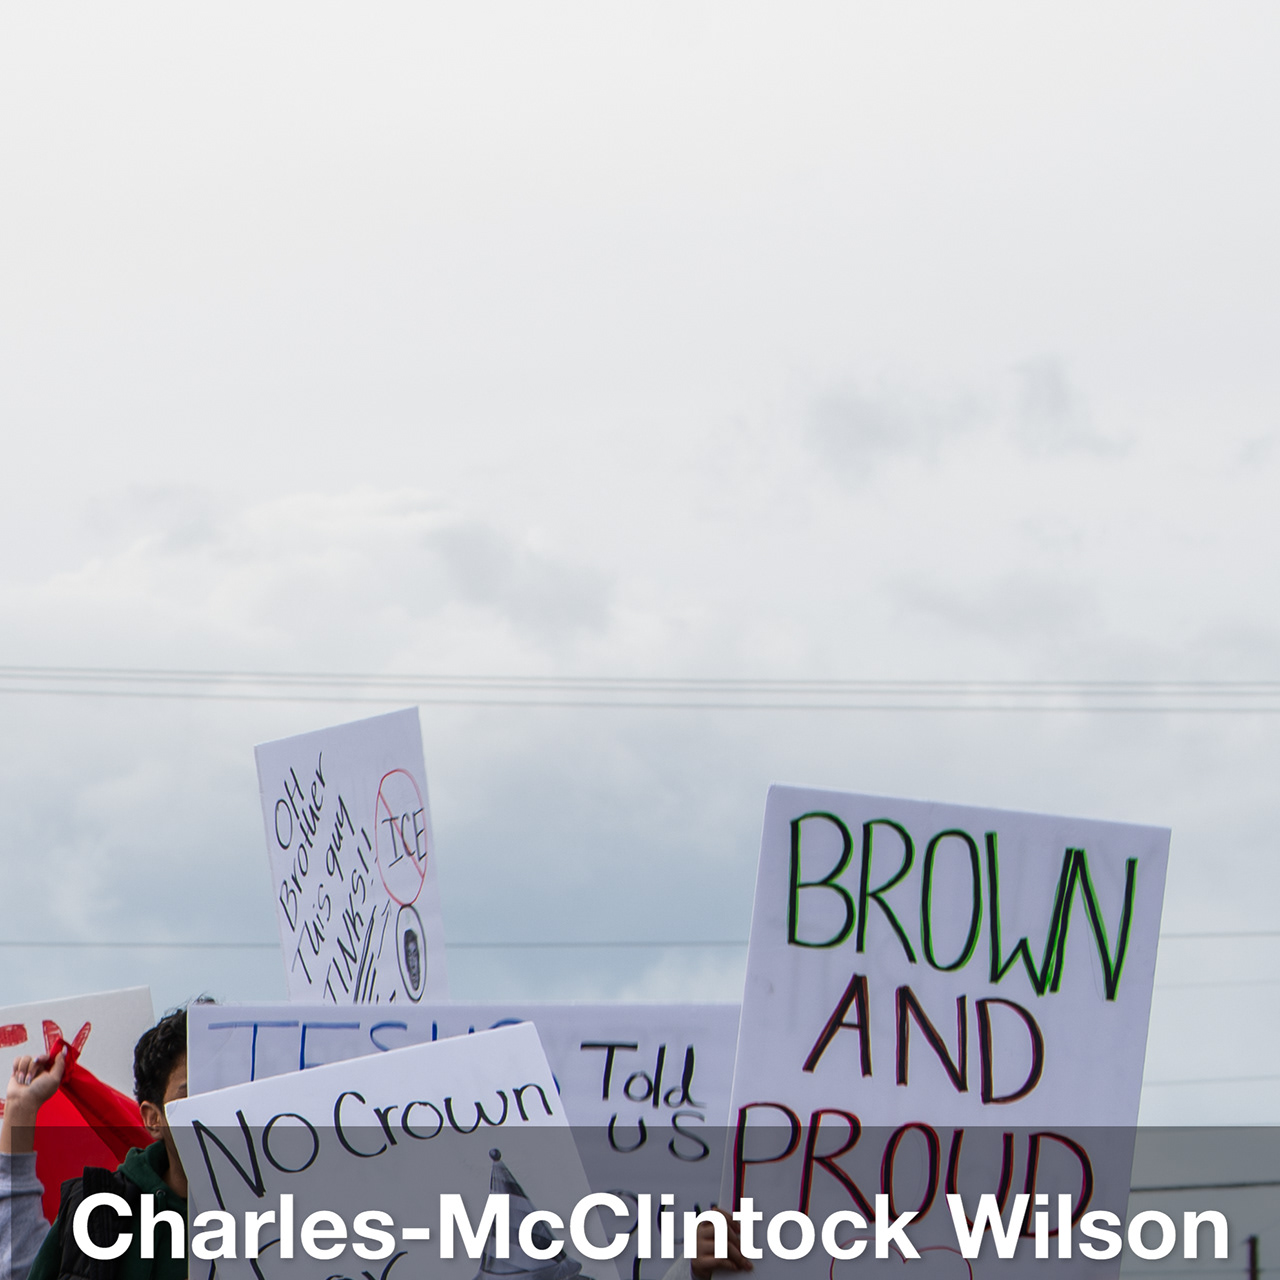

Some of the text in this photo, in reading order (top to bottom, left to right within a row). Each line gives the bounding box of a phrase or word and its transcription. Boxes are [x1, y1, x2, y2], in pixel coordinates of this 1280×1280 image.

[274, 766, 306, 851] OH
[325, 794, 356, 883] guy
[381, 806, 427, 869] ICE
[787, 810, 1139, 1002] BROWN
[580, 1040, 708, 1110] Told
[801, 972, 1045, 1105] AND
[333, 1091, 554, 1158] Crown
[731, 1101, 1094, 1240] PROUD
